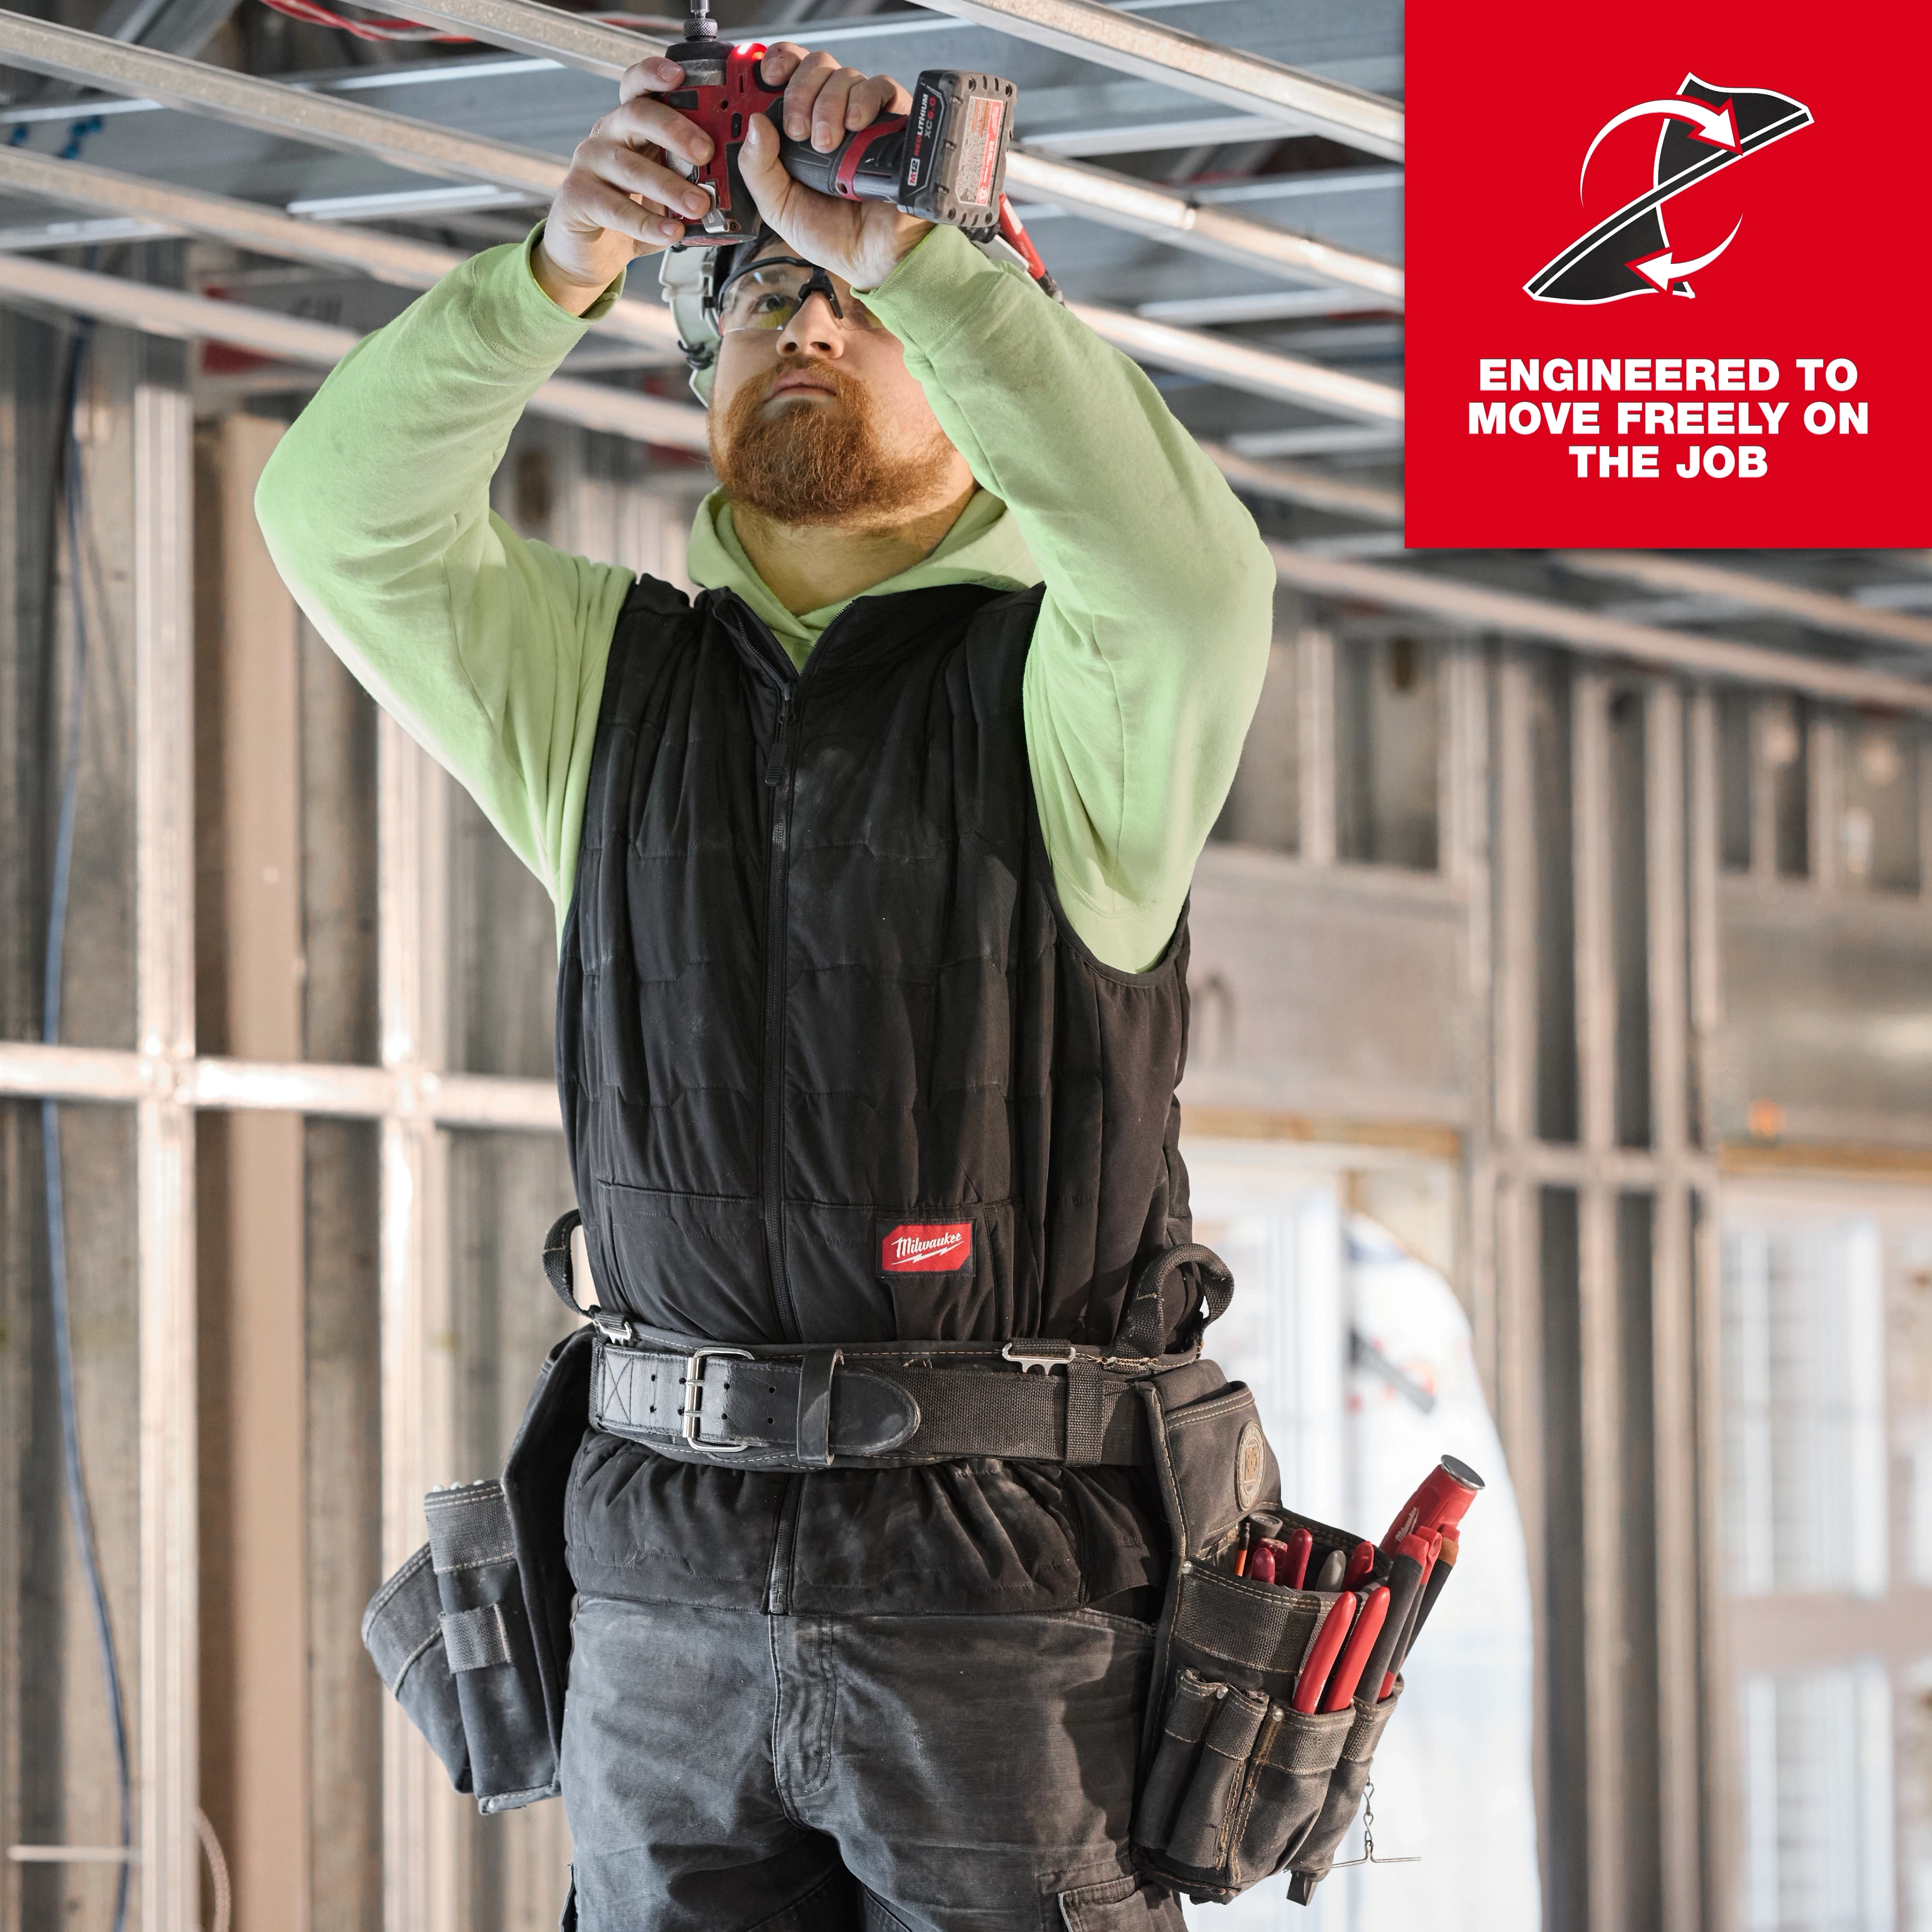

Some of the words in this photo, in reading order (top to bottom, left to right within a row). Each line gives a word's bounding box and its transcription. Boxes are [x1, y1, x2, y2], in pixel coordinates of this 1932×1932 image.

[914, 94, 928, 156] REDLITHIUM
[909, 160, 918, 184] M12
[891, 1232, 962, 1259] Milwaukee
